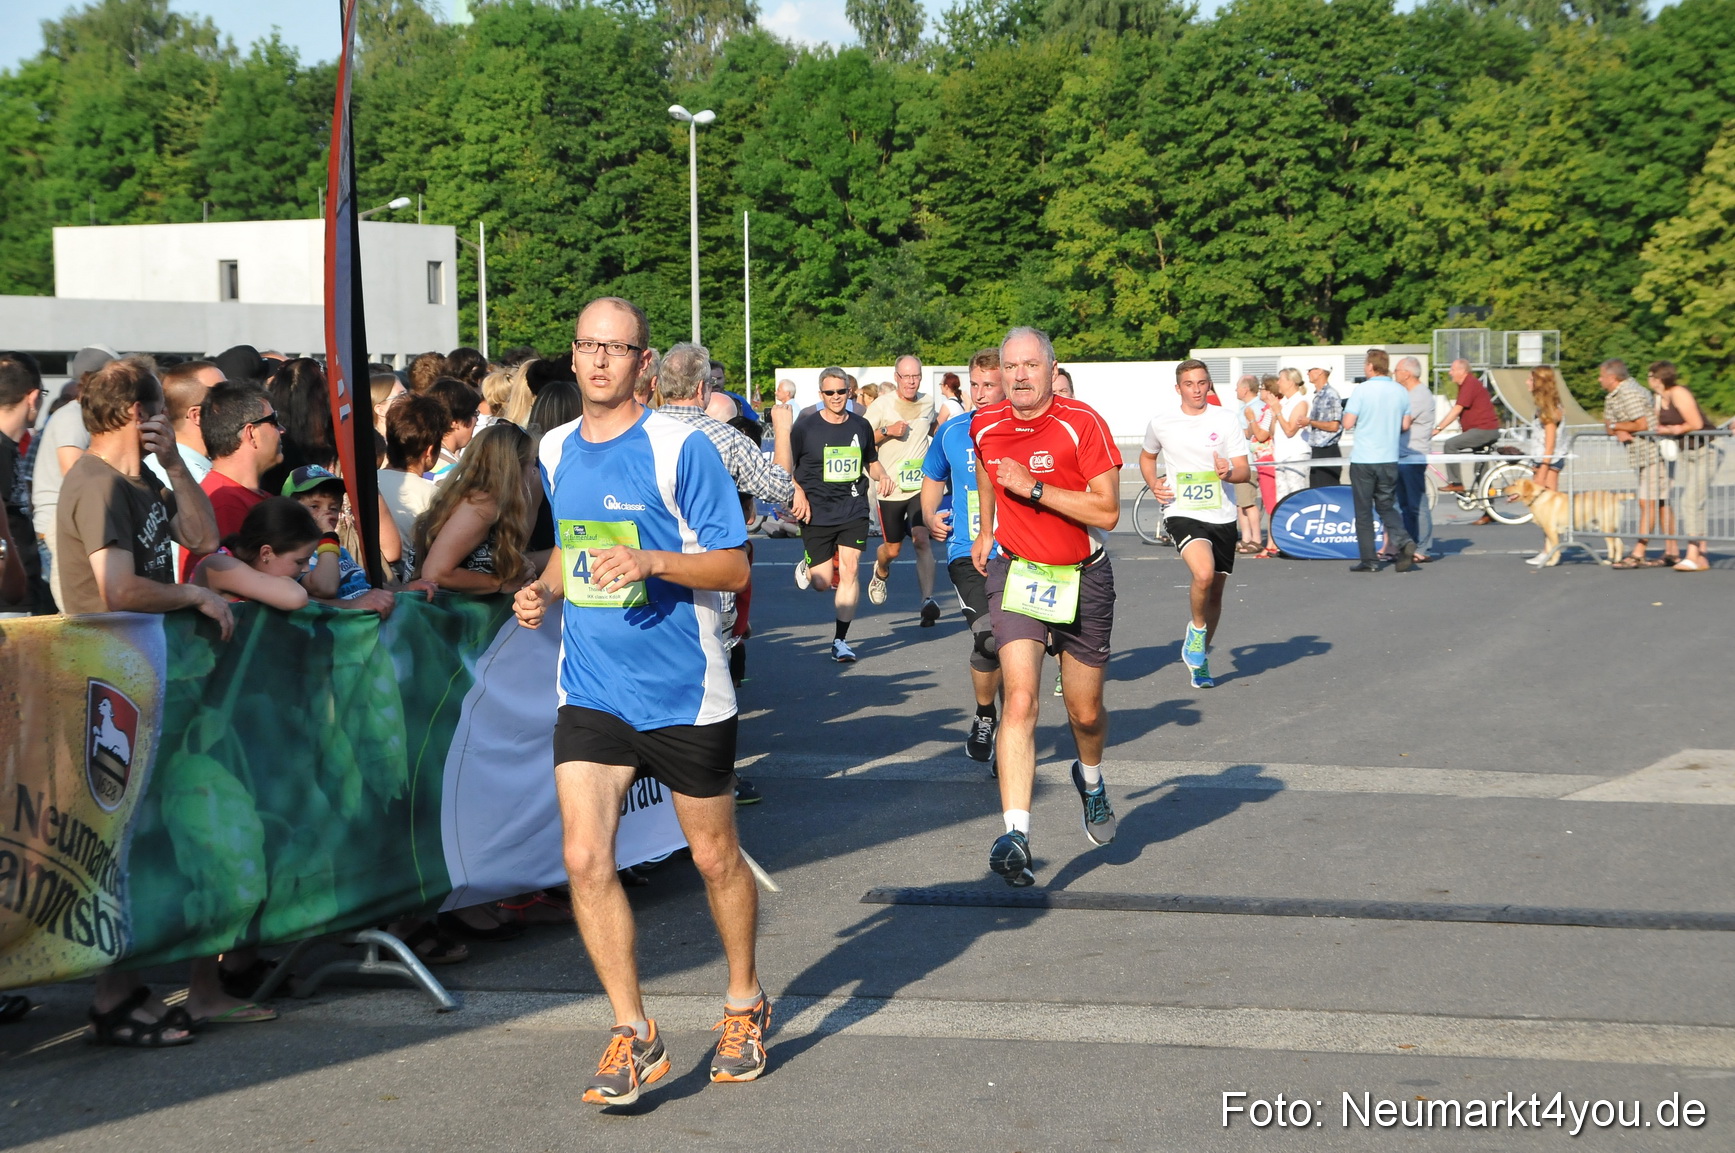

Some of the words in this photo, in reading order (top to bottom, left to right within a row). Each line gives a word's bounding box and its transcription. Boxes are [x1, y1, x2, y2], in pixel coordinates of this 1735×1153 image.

[826, 458, 858, 473] 1051
[1183, 484, 1214, 500] 425
[1025, 581, 1057, 608] 14
[95, 773, 117, 801] 1628
